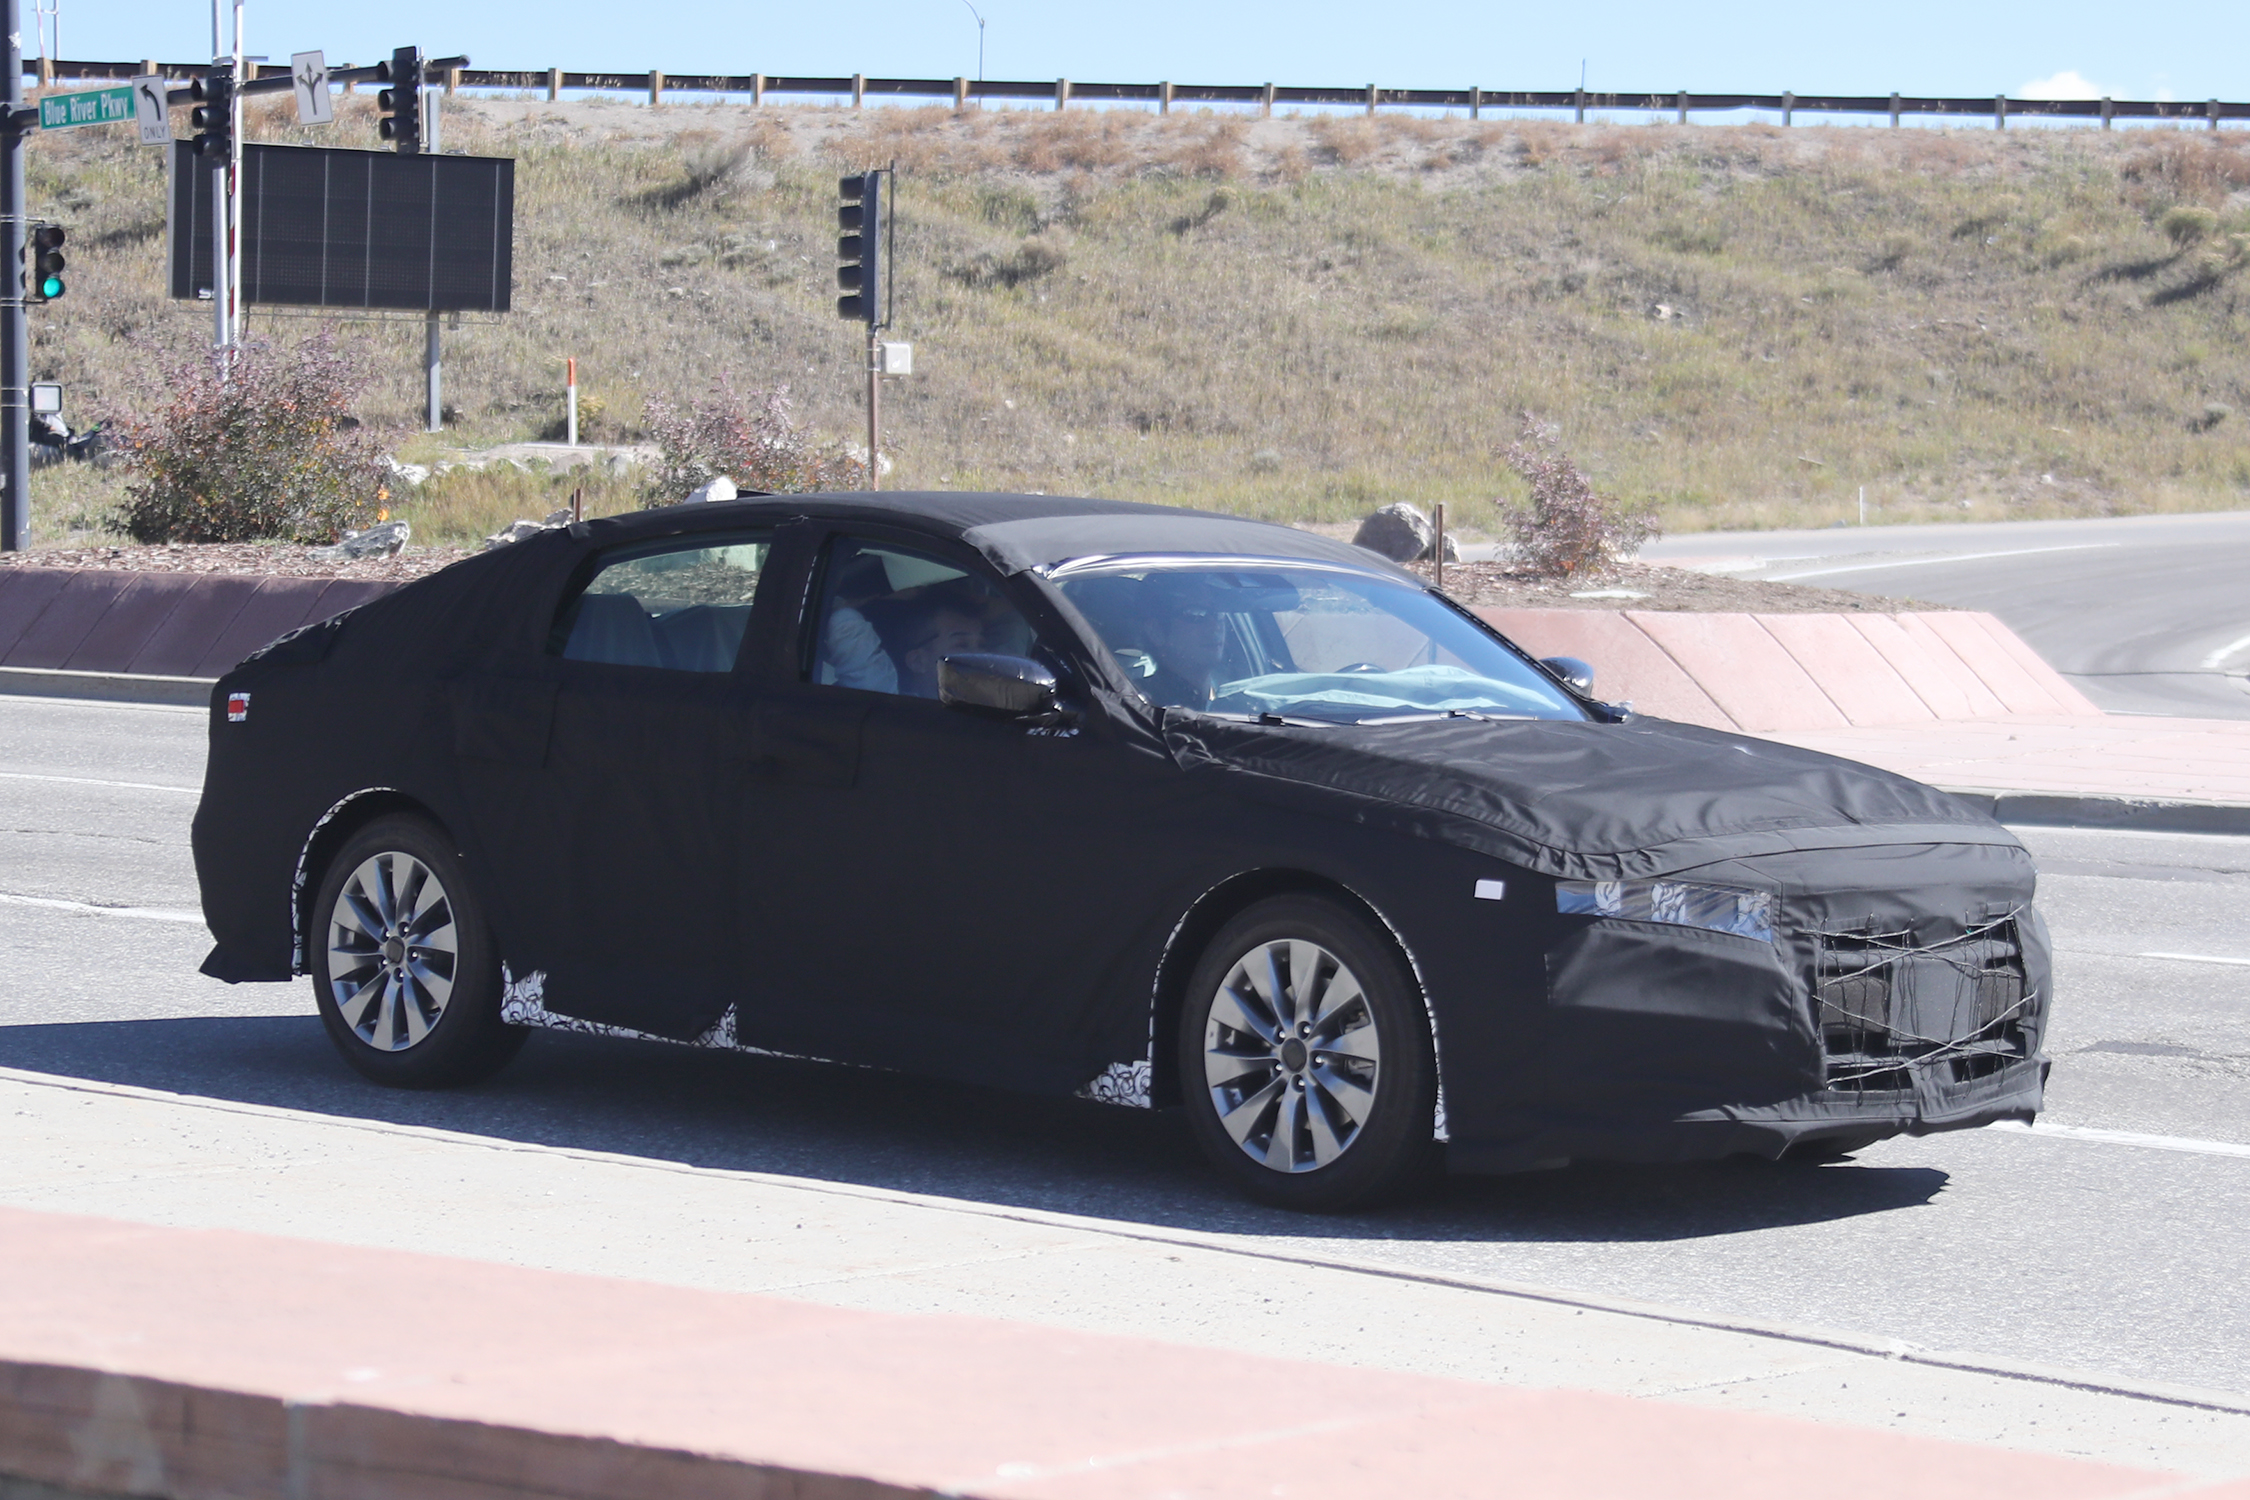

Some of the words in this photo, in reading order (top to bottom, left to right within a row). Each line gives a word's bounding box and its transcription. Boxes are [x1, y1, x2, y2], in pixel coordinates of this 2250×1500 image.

[45, 101, 67, 126] Blue
[70, 96, 97, 122] River
[100, 93, 129, 119] Pkwy
[144, 125, 166, 140] ONLY
